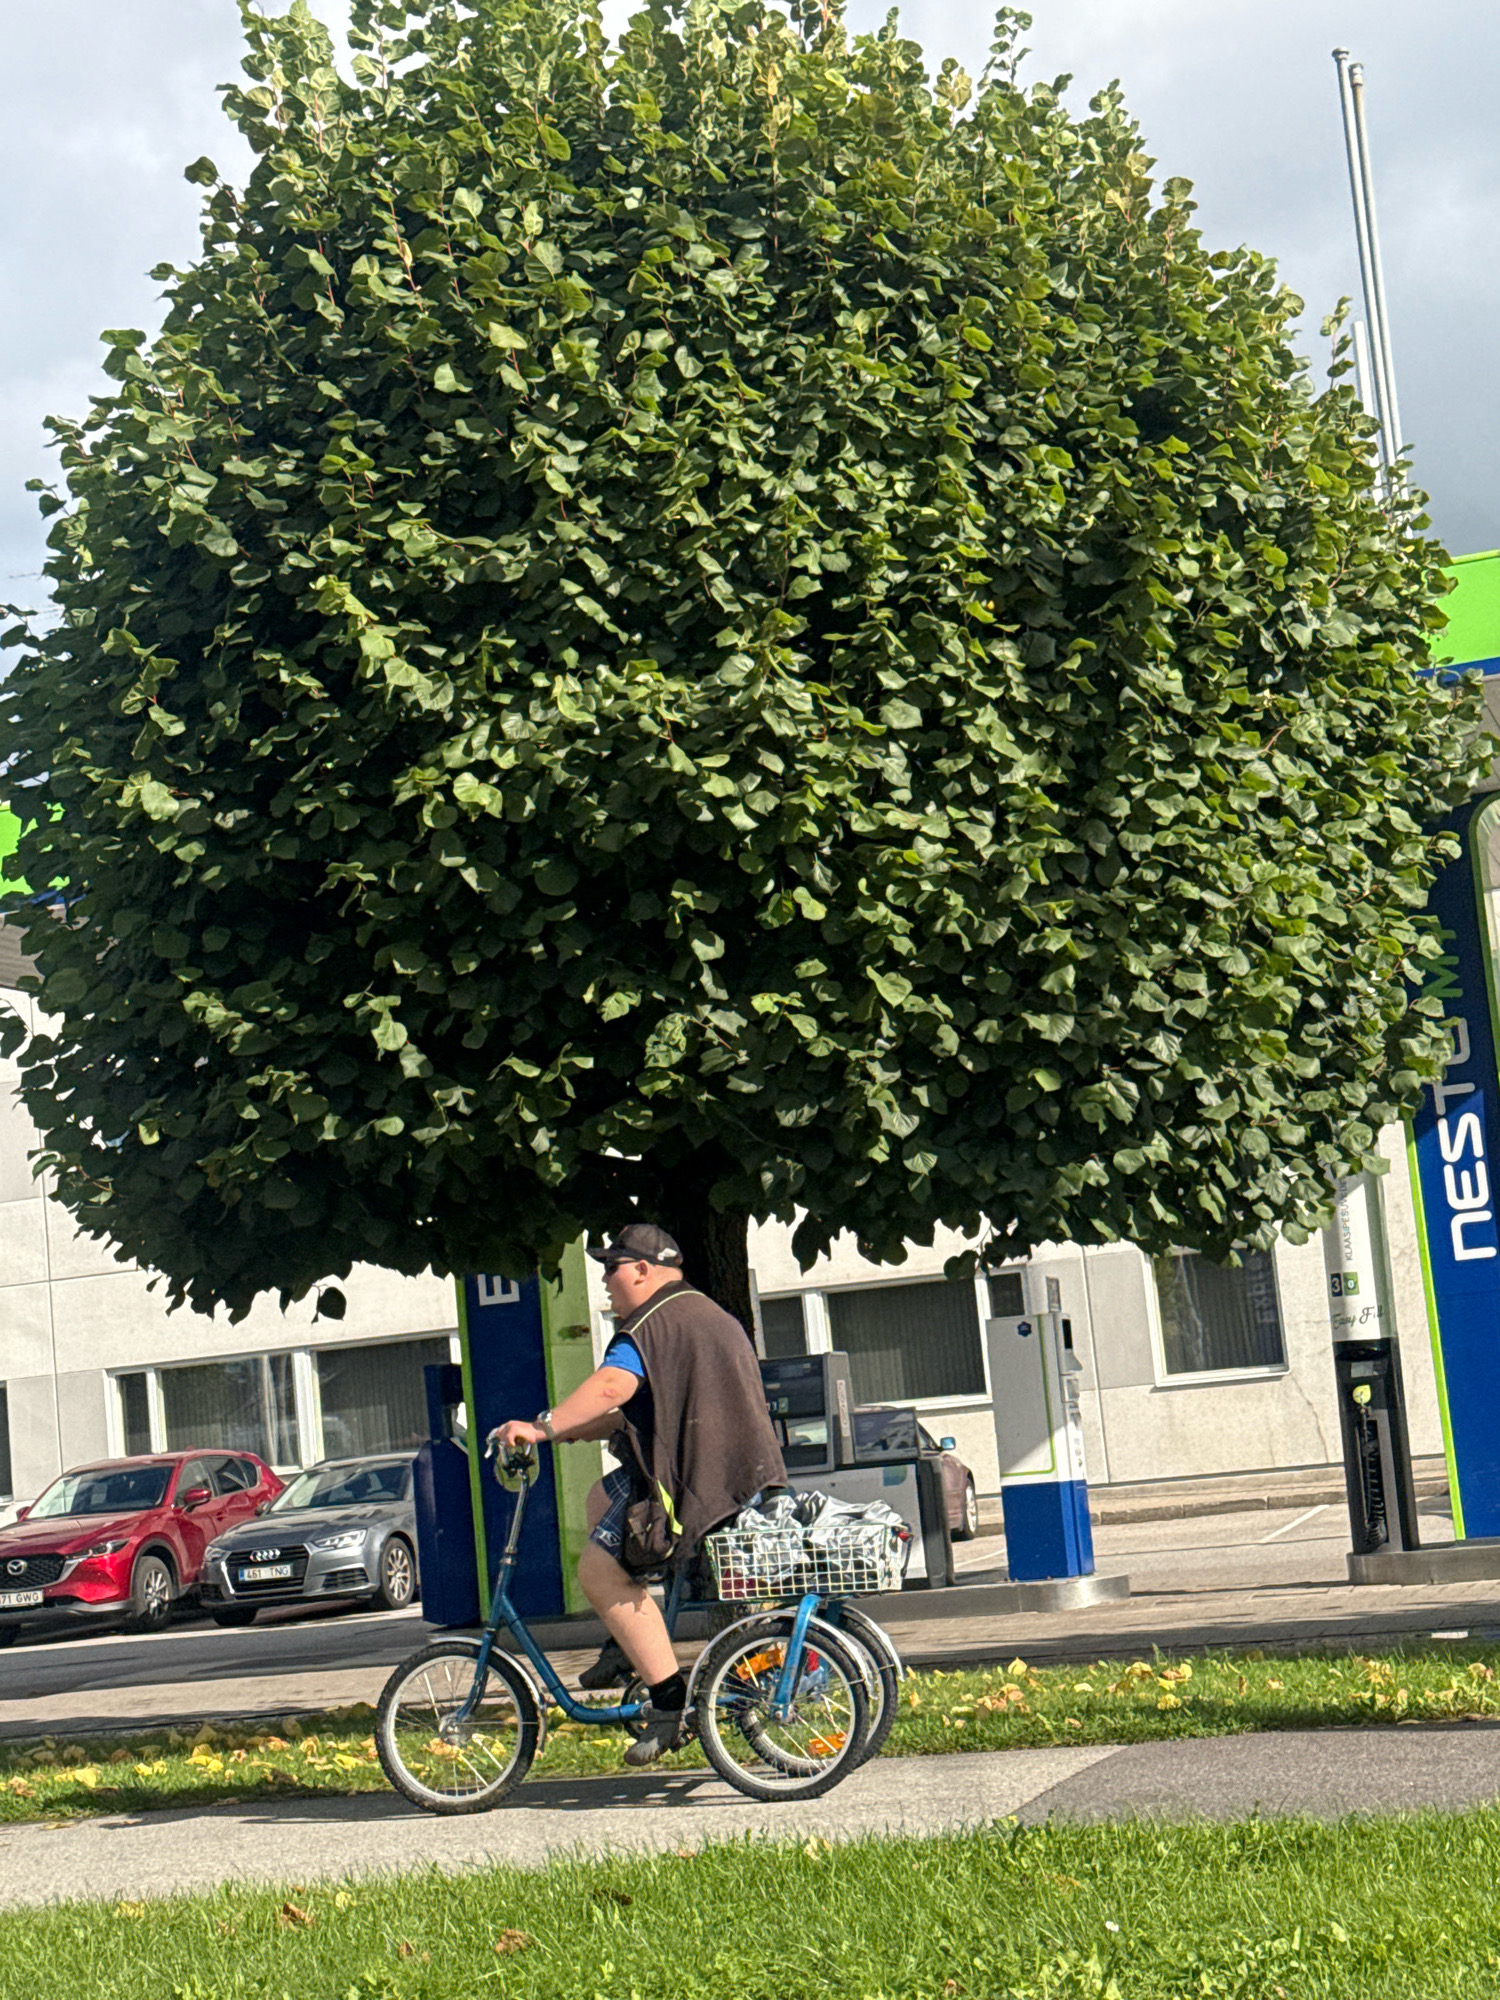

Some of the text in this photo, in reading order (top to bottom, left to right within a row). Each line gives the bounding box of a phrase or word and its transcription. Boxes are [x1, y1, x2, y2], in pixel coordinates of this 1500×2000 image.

[1331, 1277, 1341, 1294] 3
[1332, 1304, 1383, 1330] Easy Fill
[246, 1566, 289, 1579] 461 TNG
[0, 1591, 39, 1605] 71 GWG
